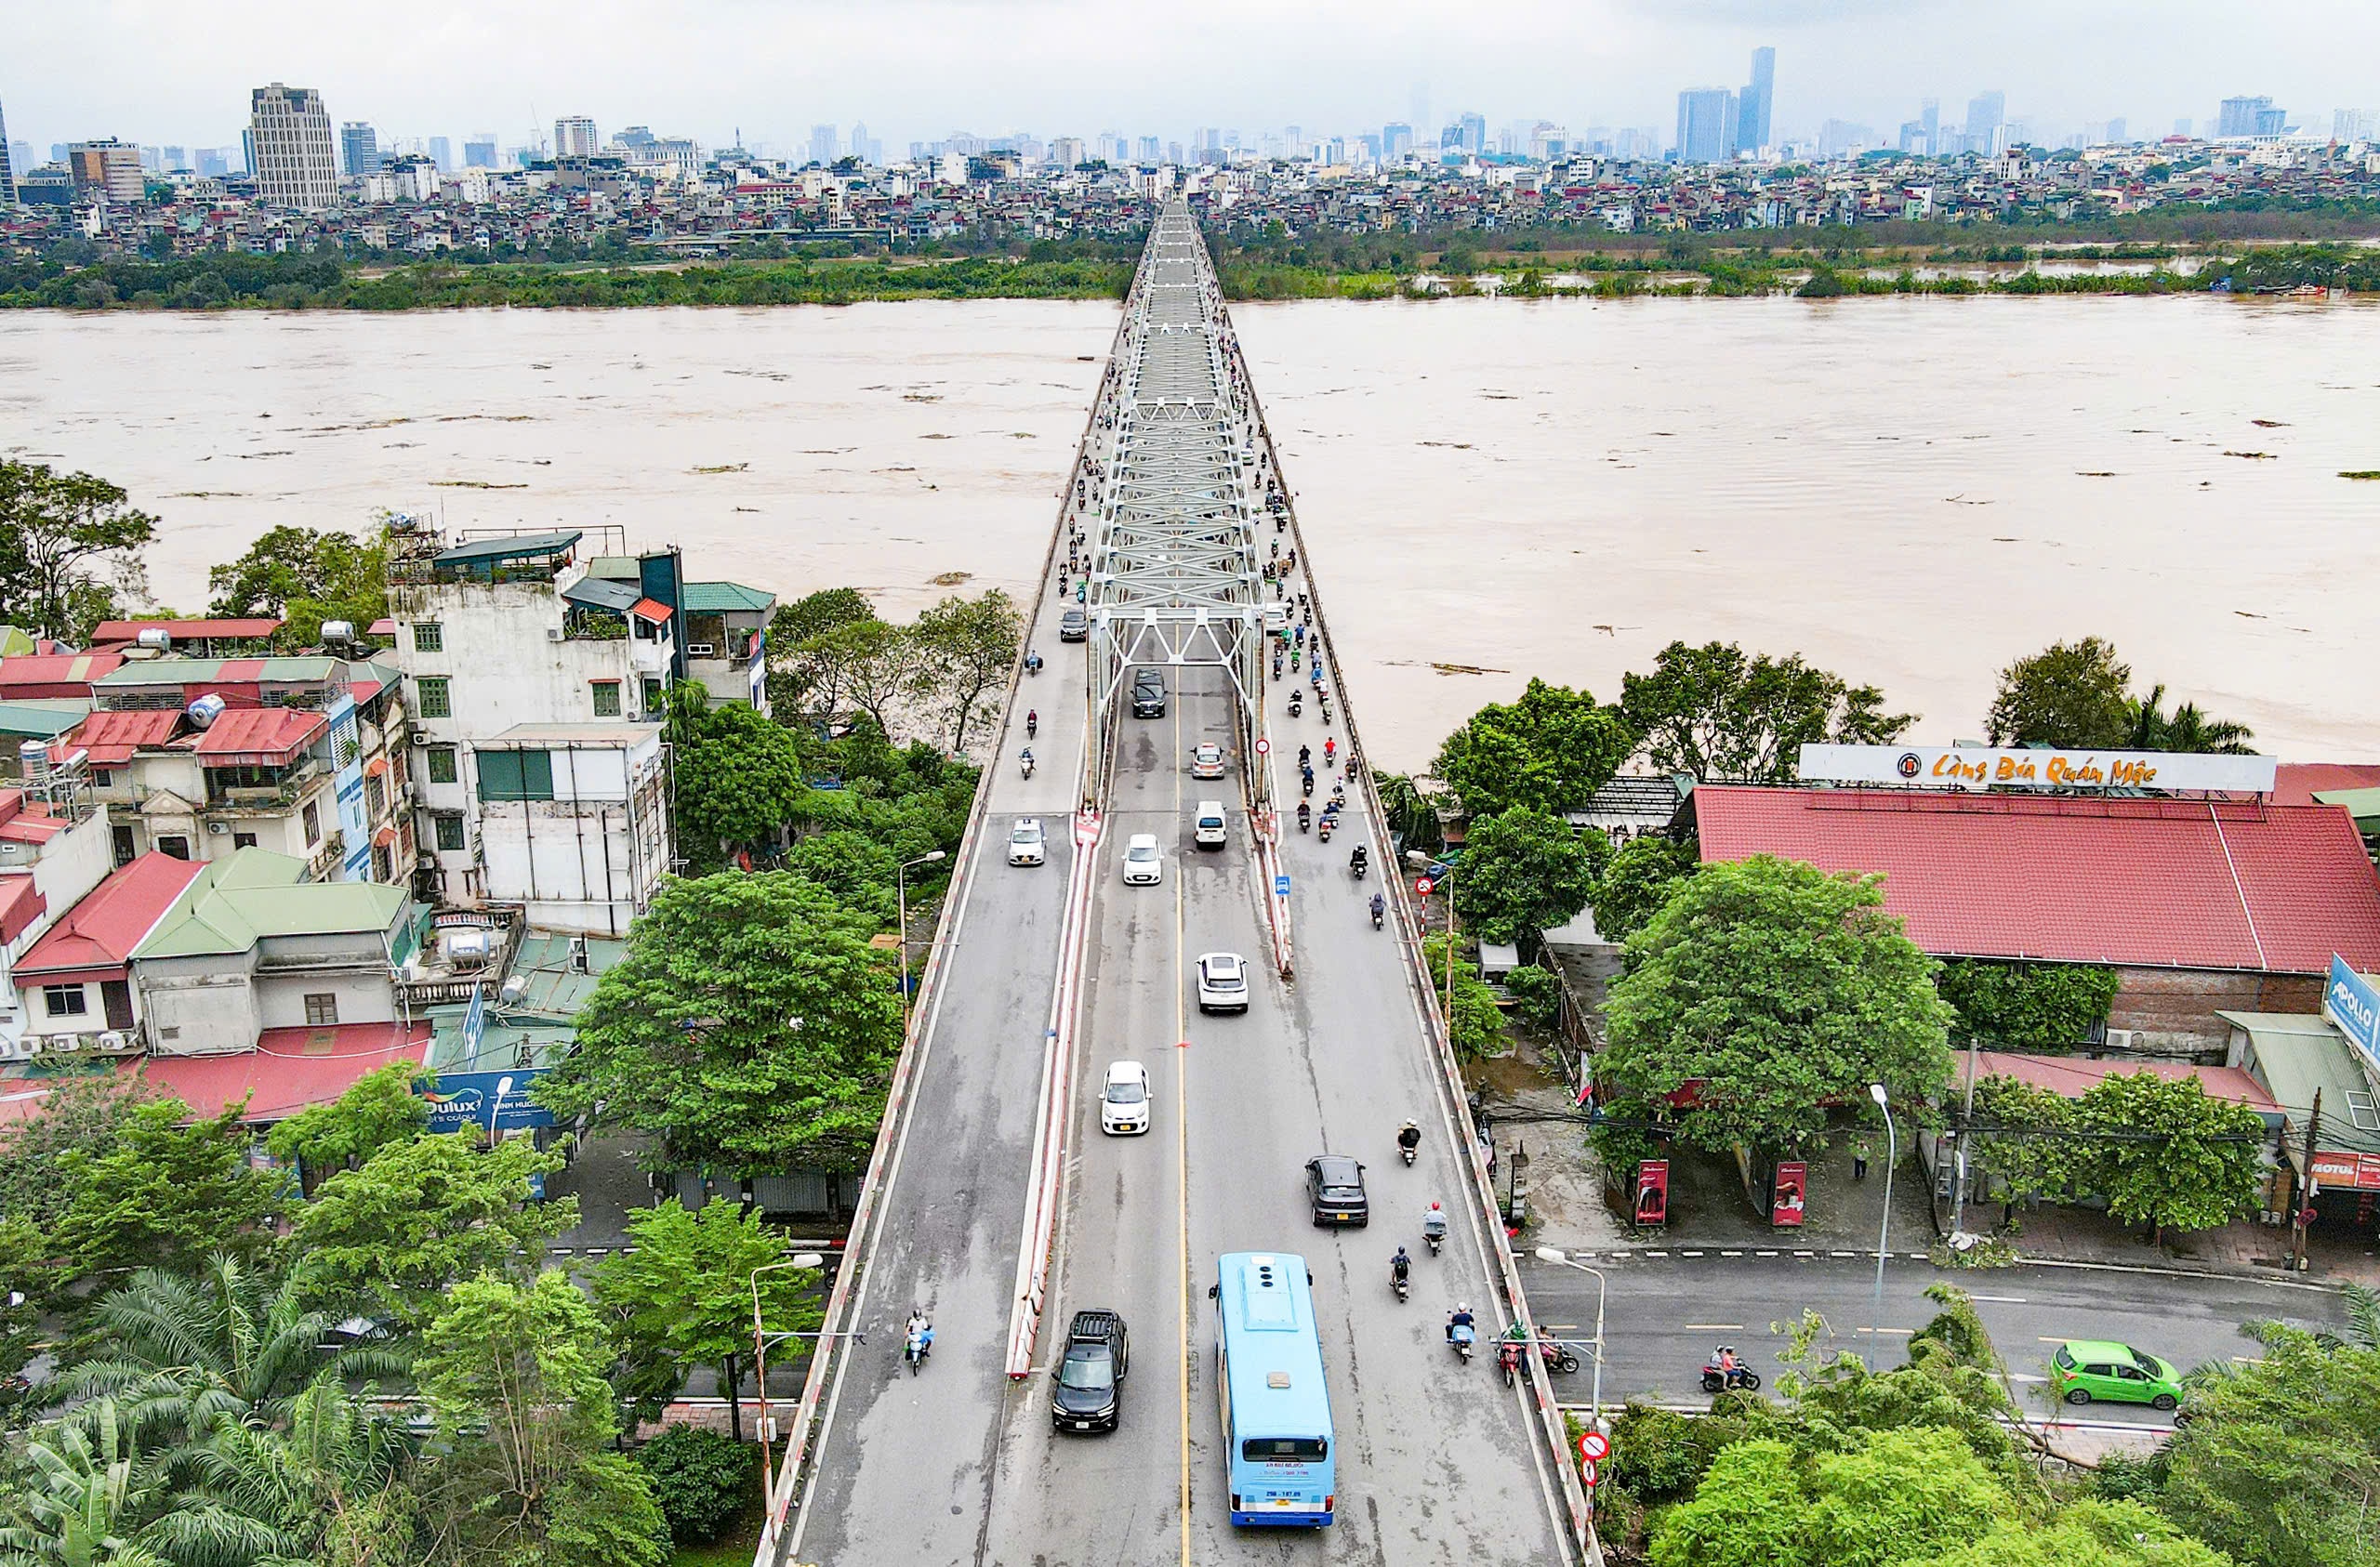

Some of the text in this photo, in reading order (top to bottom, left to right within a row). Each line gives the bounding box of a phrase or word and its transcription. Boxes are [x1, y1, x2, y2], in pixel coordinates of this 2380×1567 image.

[1932, 754, 1988, 783] Làng
[2046, 756, 2103, 785] Quán
[2109, 758, 2157, 786] Mộc
[2332, 981, 2372, 1027] APOLLO
[424, 1100, 476, 1114] Dulux
[2311, 1164, 2354, 1176] MOTUL
